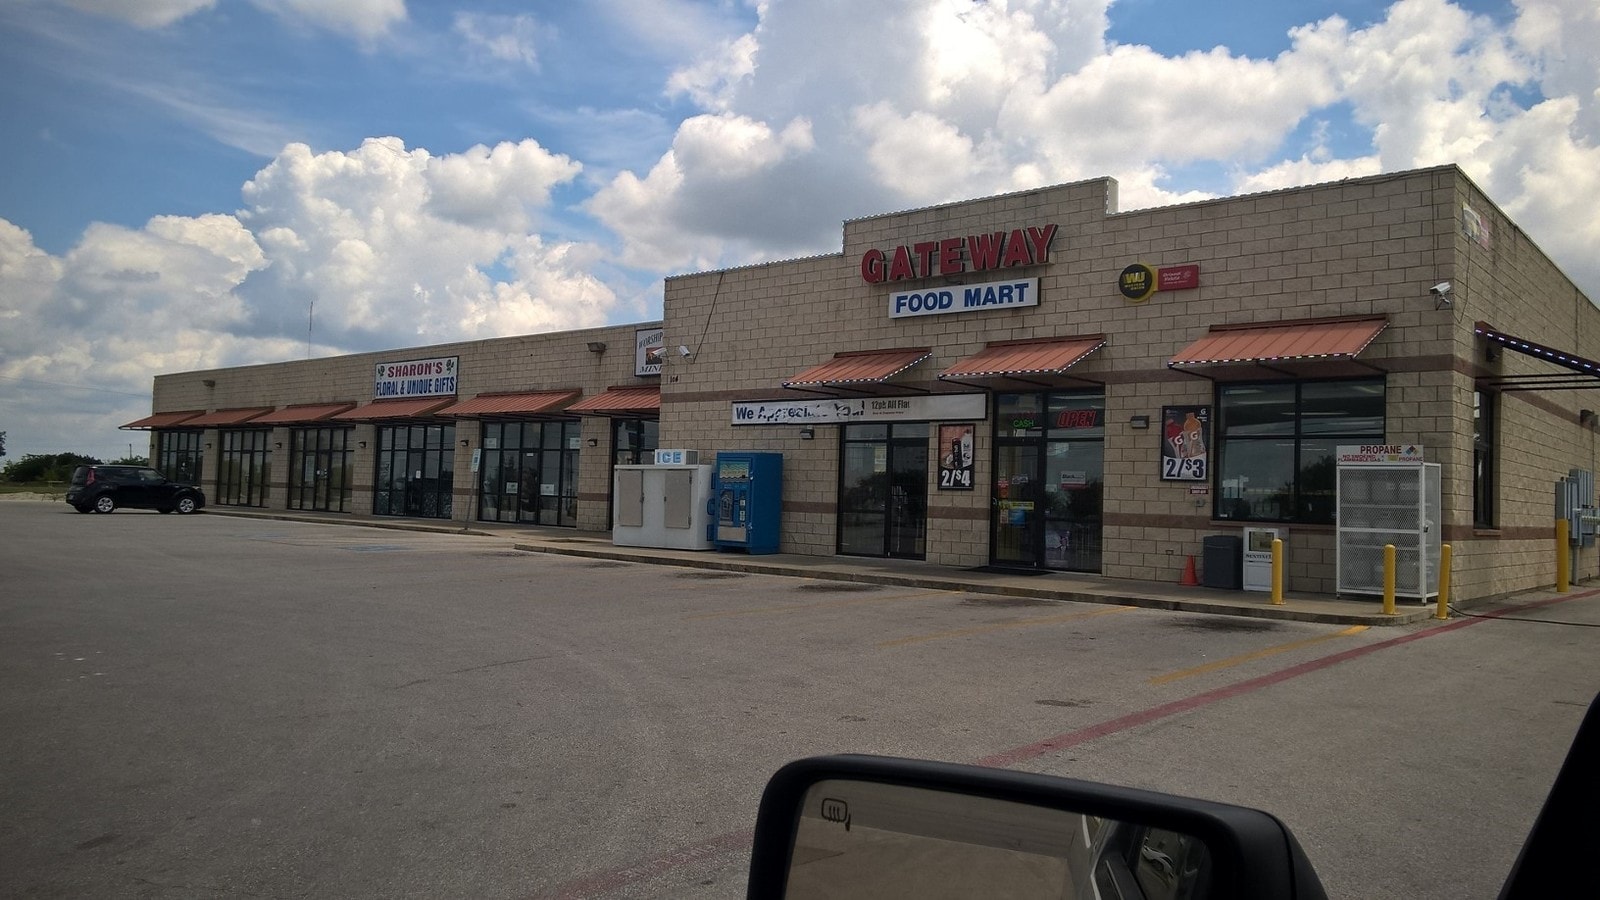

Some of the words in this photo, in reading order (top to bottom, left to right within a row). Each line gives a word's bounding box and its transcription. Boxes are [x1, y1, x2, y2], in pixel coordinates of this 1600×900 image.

[861, 224, 1058, 283] GATEWAY
[1123, 272, 1146, 284] WU
[895, 291, 953, 314] FOOD
[964, 283, 1030, 308] MART
[638, 331, 664, 350] WORSHIP
[387, 361, 443, 378] SHARON'S
[375, 380, 399, 396] FLORAL
[400, 380, 405, 395] &
[406, 378, 433, 395] UNIQUE
[434, 376, 455, 393] GIFTS
[736, 406, 754, 420] We
[1057, 410, 1096, 428] OPEN
[1013, 419, 1035, 428] CASH
[1174, 435, 1184, 445] G
[1190, 431, 1199, 440] G
[656, 451, 682, 464] ICE
[1360, 445, 1402, 455] PROPANE
[1165, 458, 1204, 478] 2/$3
[941, 469, 971, 487] 2/$4
